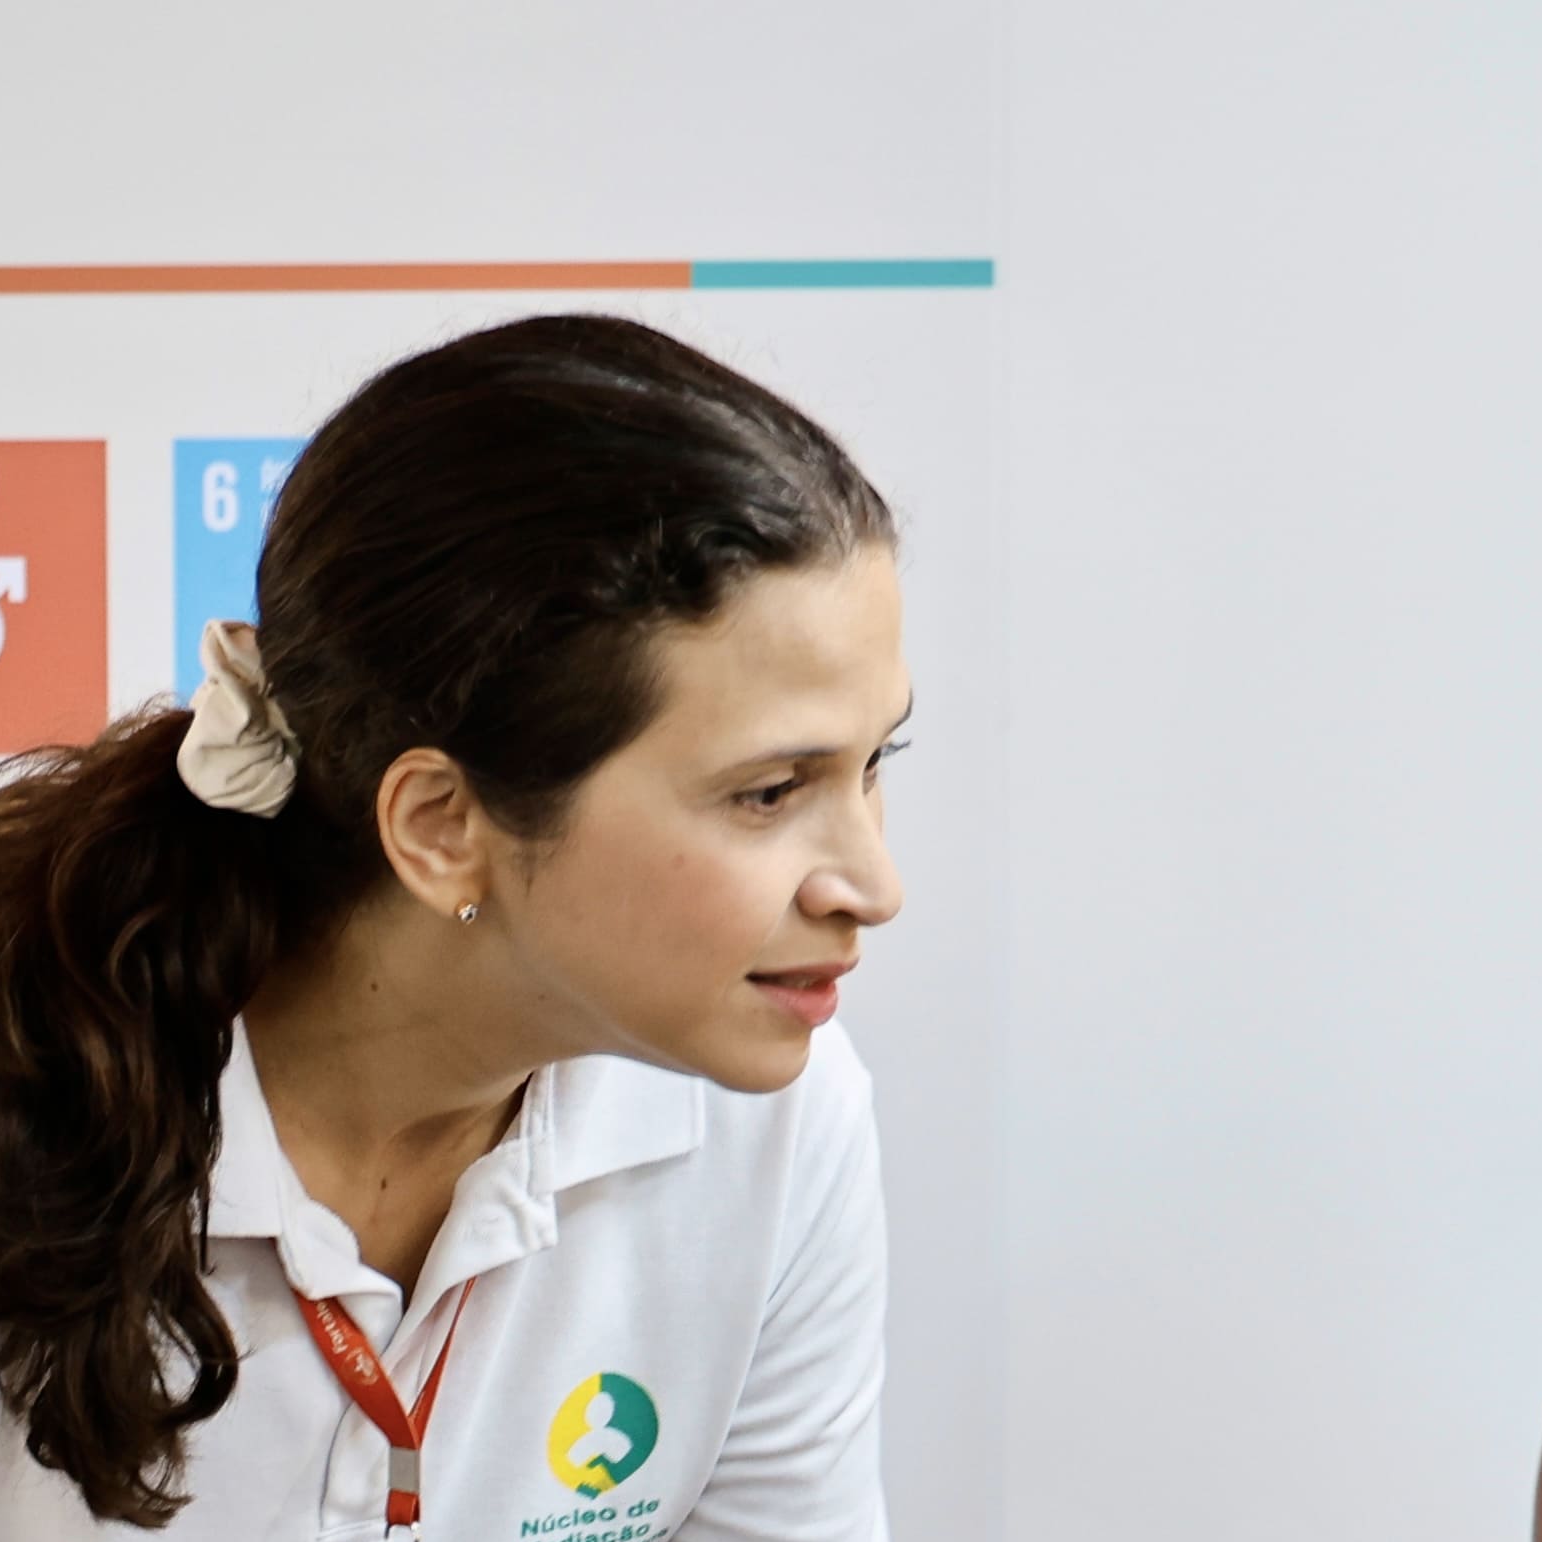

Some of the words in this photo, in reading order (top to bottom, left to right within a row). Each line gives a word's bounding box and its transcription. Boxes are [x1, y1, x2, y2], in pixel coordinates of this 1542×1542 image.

[202, 461, 240, 532] 6
[521, 1508, 617, 1537] Núcleo
[628, 1499, 660, 1518] de
